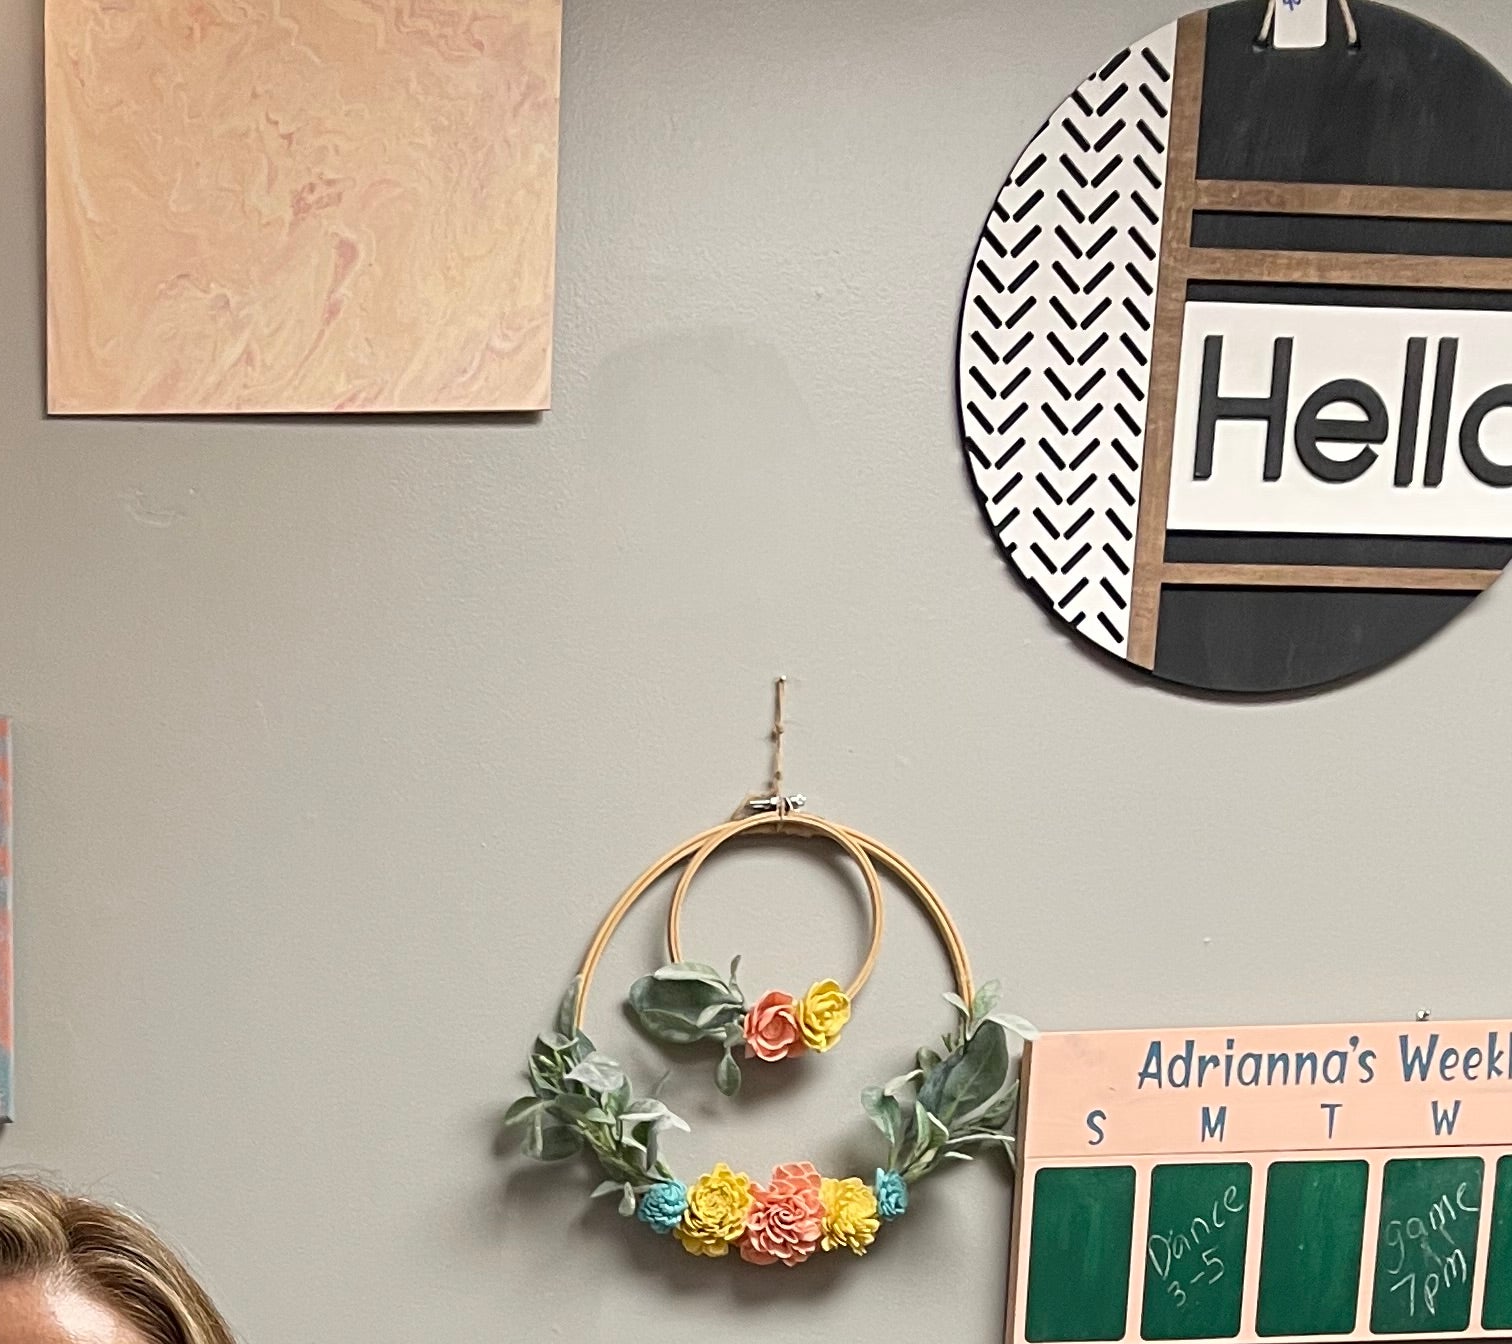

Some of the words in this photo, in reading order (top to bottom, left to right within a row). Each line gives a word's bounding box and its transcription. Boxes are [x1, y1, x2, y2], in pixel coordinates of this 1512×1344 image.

[1192, 335, 1512, 488] Hello
[1138, 1036, 1376, 1089] Adrianna's
[1399, 1031, 1512, 1082] Week
[1087, 1110, 1107, 1145] S
[1201, 1106, 1227, 1142] M
[1320, 1103, 1343, 1139] T
[1431, 1100, 1461, 1135] W
[1148, 1186, 1244, 1280] Dance
